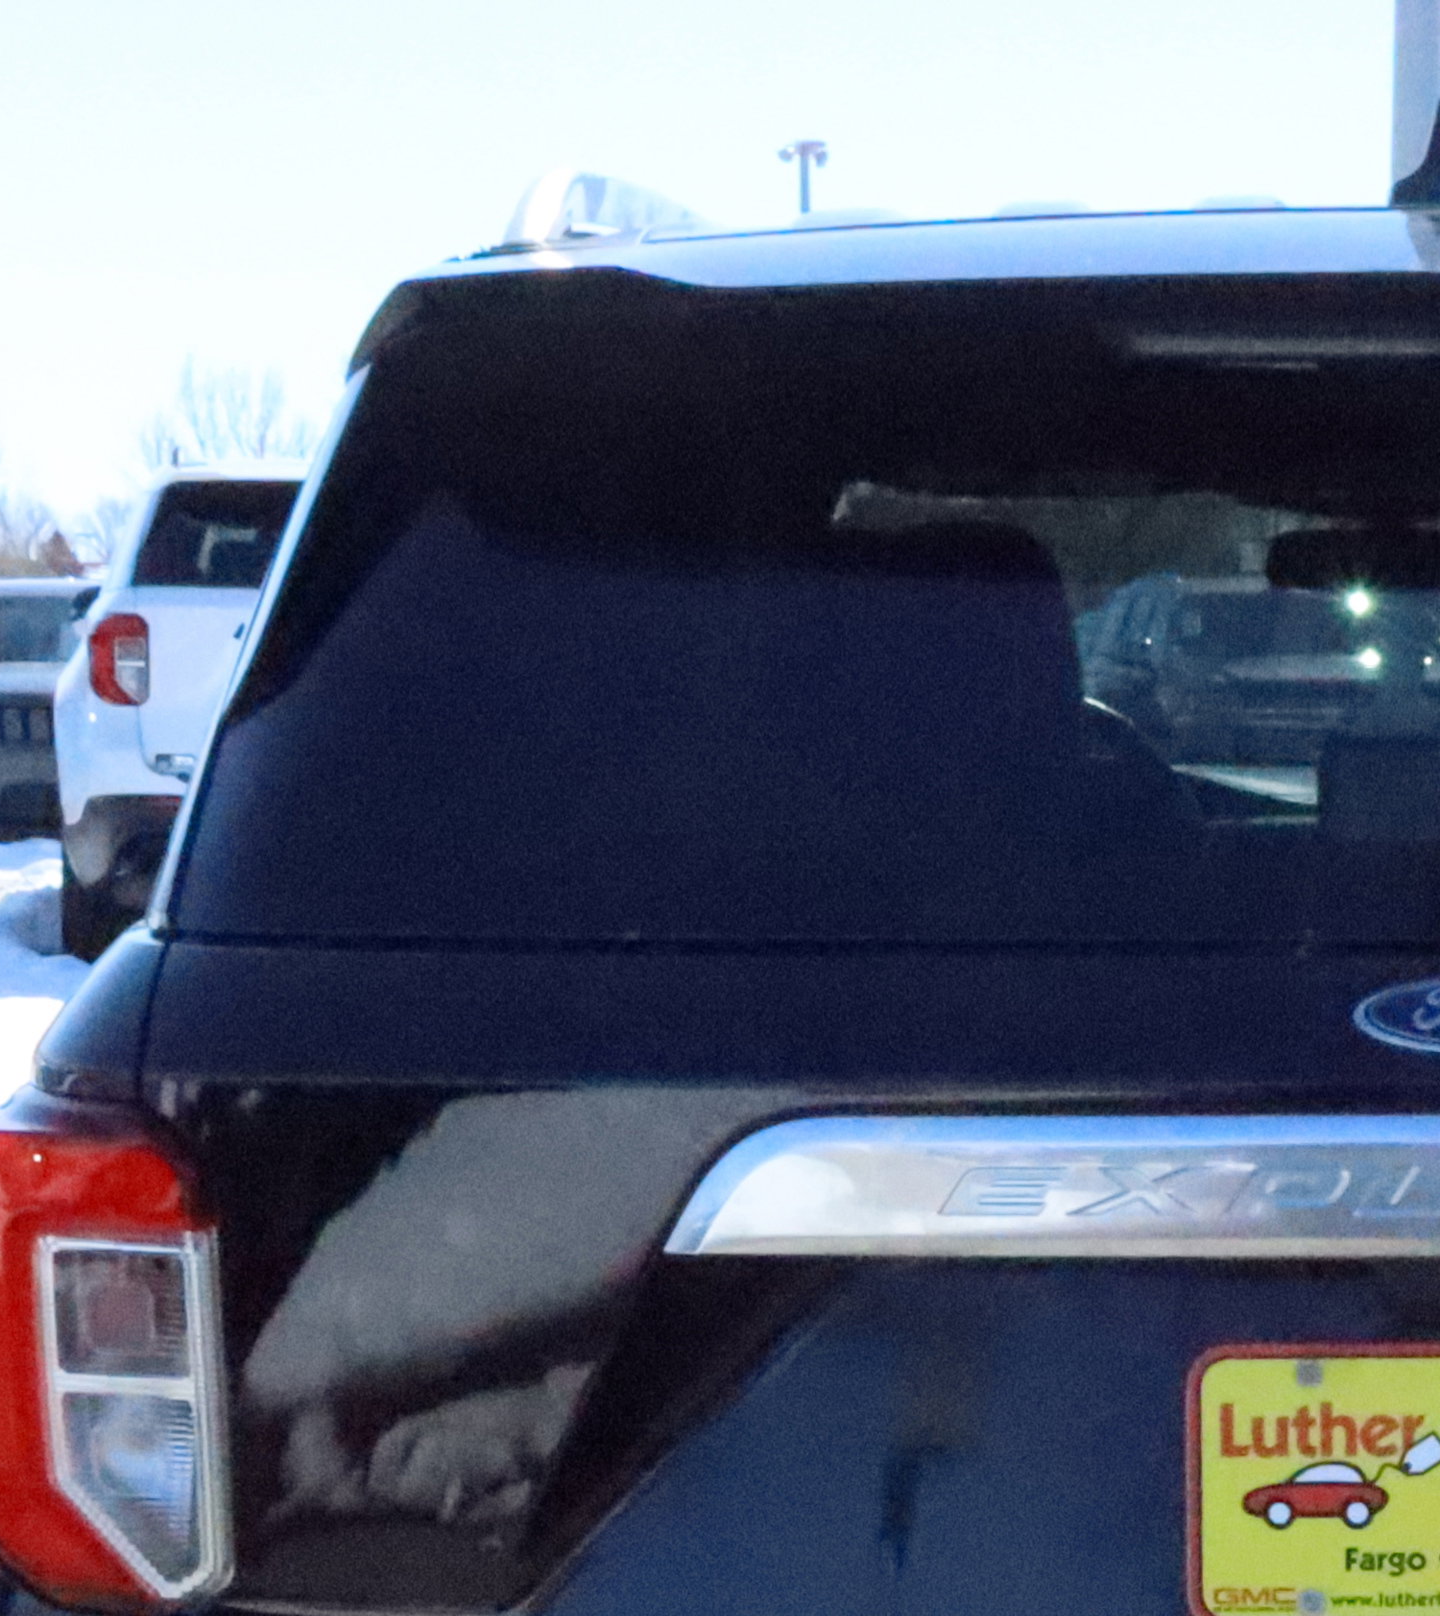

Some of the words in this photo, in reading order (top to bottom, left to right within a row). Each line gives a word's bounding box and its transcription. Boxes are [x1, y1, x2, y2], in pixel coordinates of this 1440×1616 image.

[1219, 1402, 1425, 1458] Luther
[1344, 1547, 1426, 1576] Fargo
[1213, 1587, 1296, 1605] GMC
